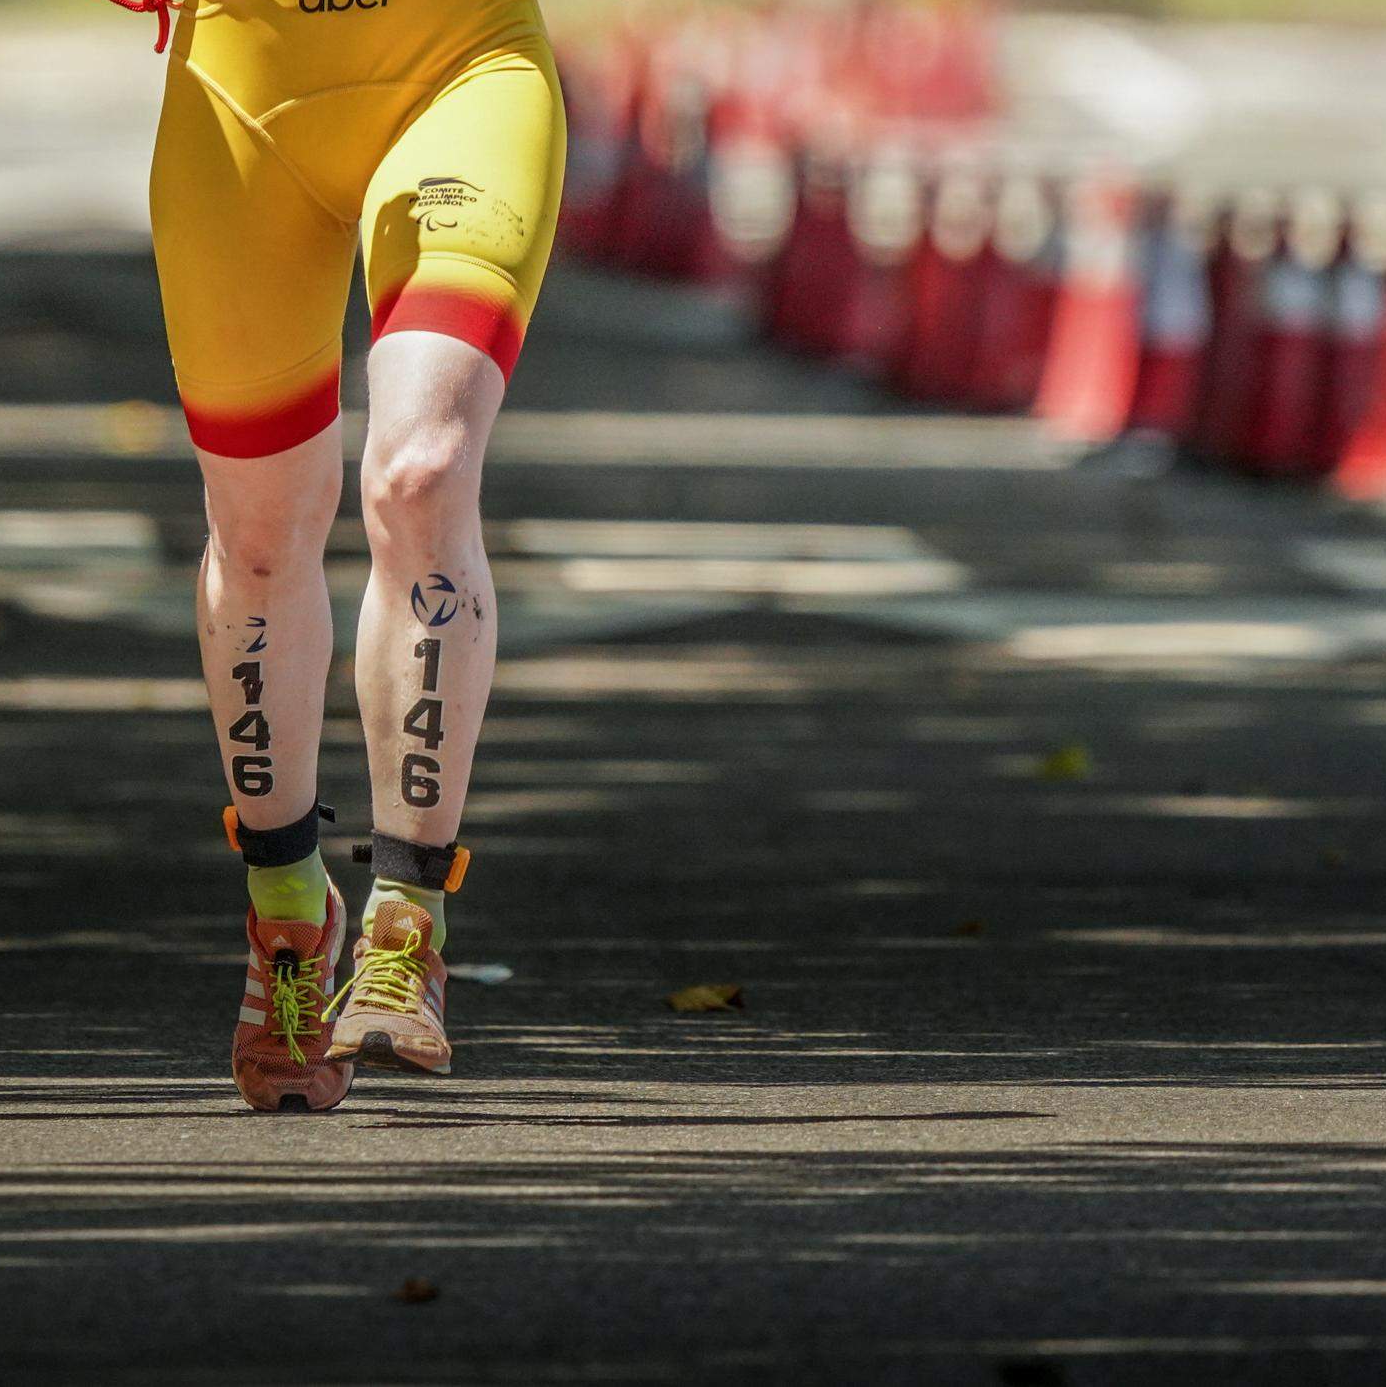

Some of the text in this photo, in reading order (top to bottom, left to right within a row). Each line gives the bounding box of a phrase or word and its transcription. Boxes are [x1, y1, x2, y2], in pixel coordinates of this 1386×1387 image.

[418, 199, 464, 207] ESPAÑOL
[425, 187, 464, 195] COMITÉ
[230, 662, 274, 797] 146
[401, 638, 444, 808] 146
